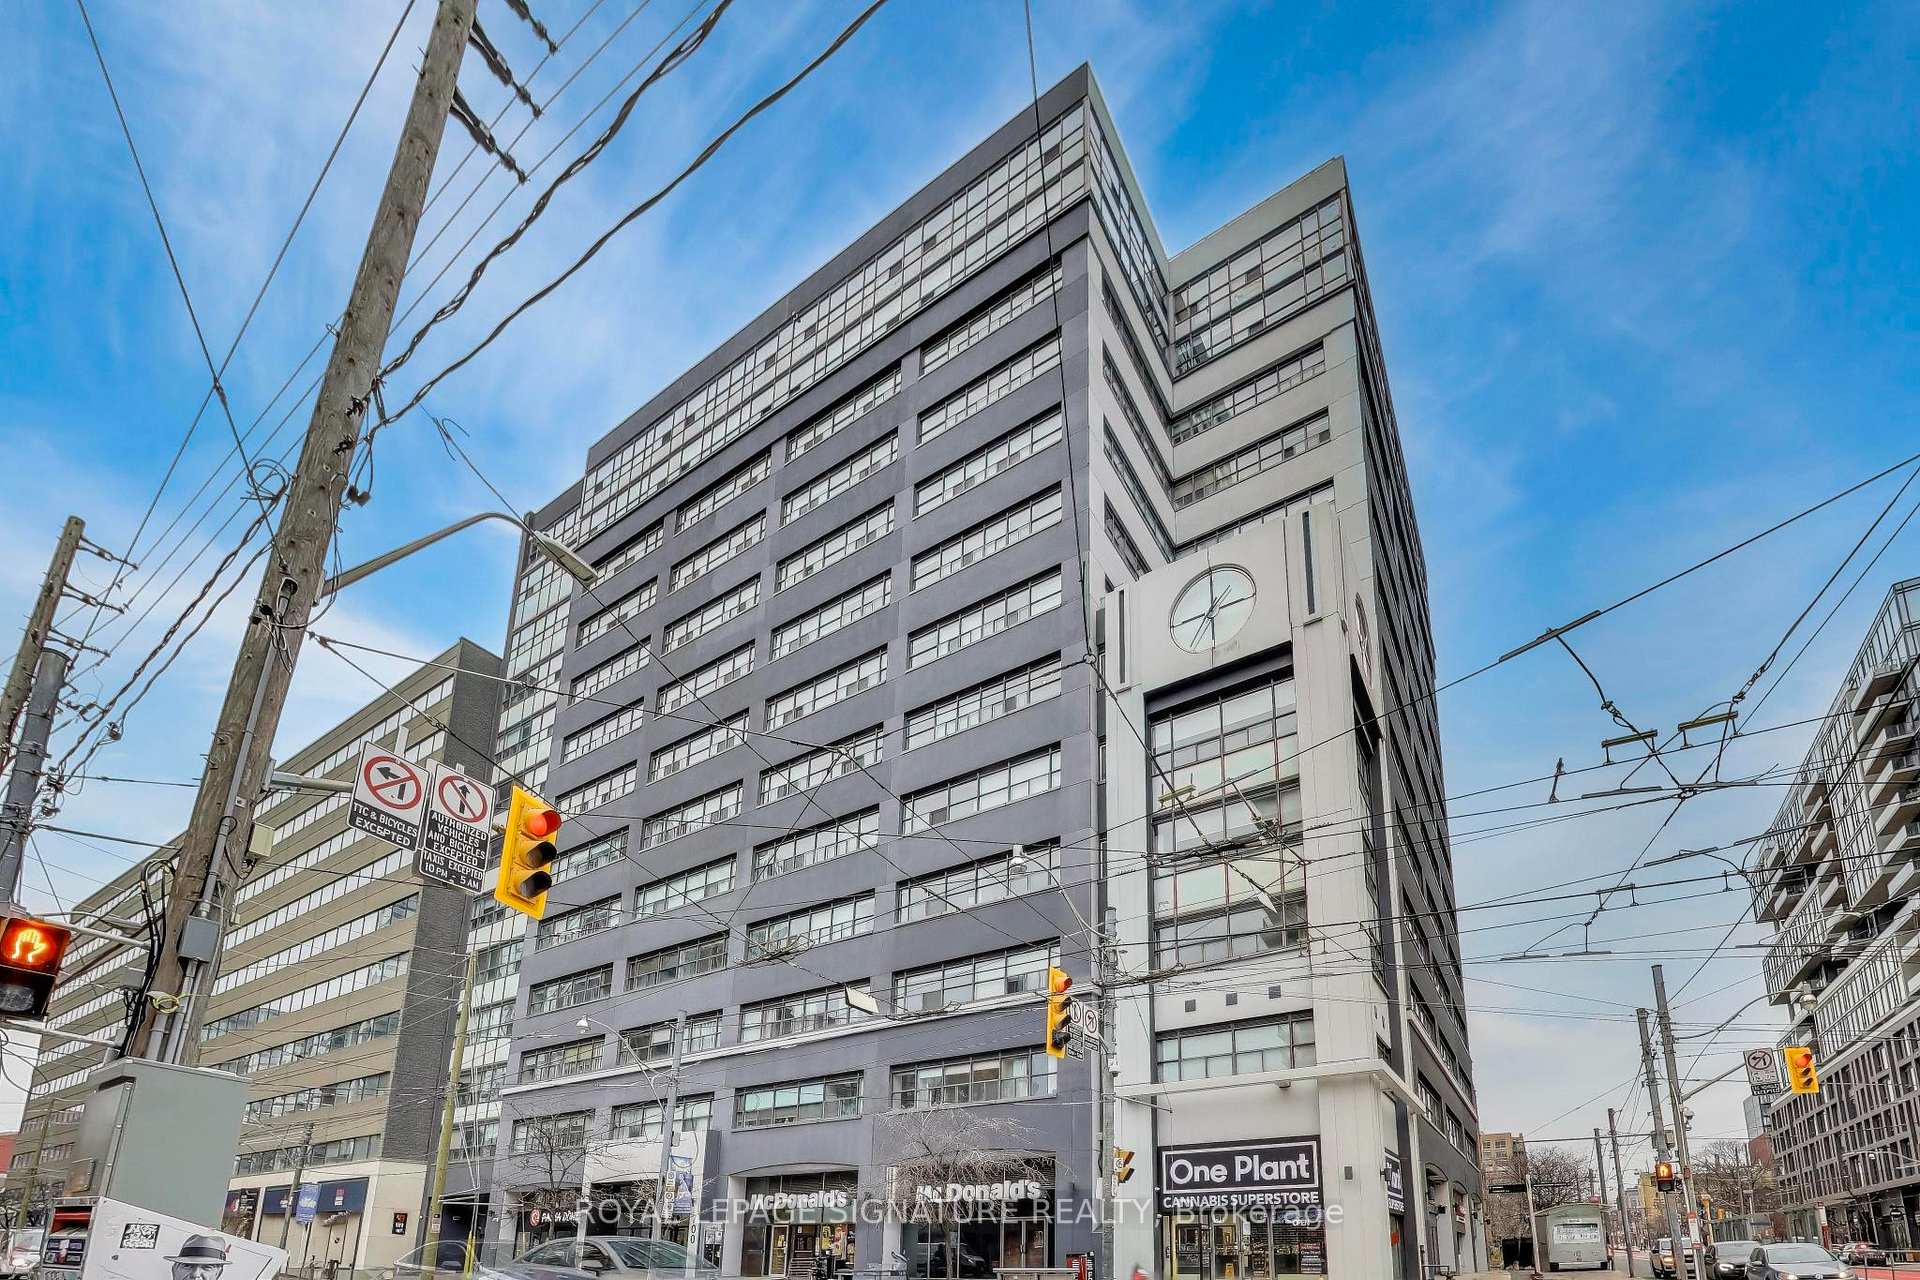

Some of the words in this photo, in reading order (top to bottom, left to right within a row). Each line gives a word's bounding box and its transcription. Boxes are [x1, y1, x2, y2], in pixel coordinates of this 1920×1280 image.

[352, 803, 370, 817] TTC
[370, 810, 378, 821] &
[379, 813, 418, 837] BICYCLES
[355, 818, 411, 846] EXCEPTED
[431, 812, 487, 841] AUTHORIZED
[428, 830, 445, 844] AND
[449, 838, 486, 859] BICYCLES
[437, 824, 480, 847] VEHICLES
[423, 850, 444, 866] TAXIS
[448, 861, 484, 880] EXCEPTED
[433, 842, 479, 866] EXCEPTED
[425, 863, 434, 873] 10
[435, 867, 448, 879] PM
[460, 875, 466, 885] 5
[466, 878, 479, 890] AM
[1169, 1158, 1229, 1186] One
[1235, 1152, 1310, 1183] Plant
[750, 1189, 848, 1211] McDonald's
[916, 1179, 1044, 1203] McDonald's
[1163, 1193, 1229, 1209] CANNABIS
[1230, 1191, 1320, 1207] SUPERSTORE
